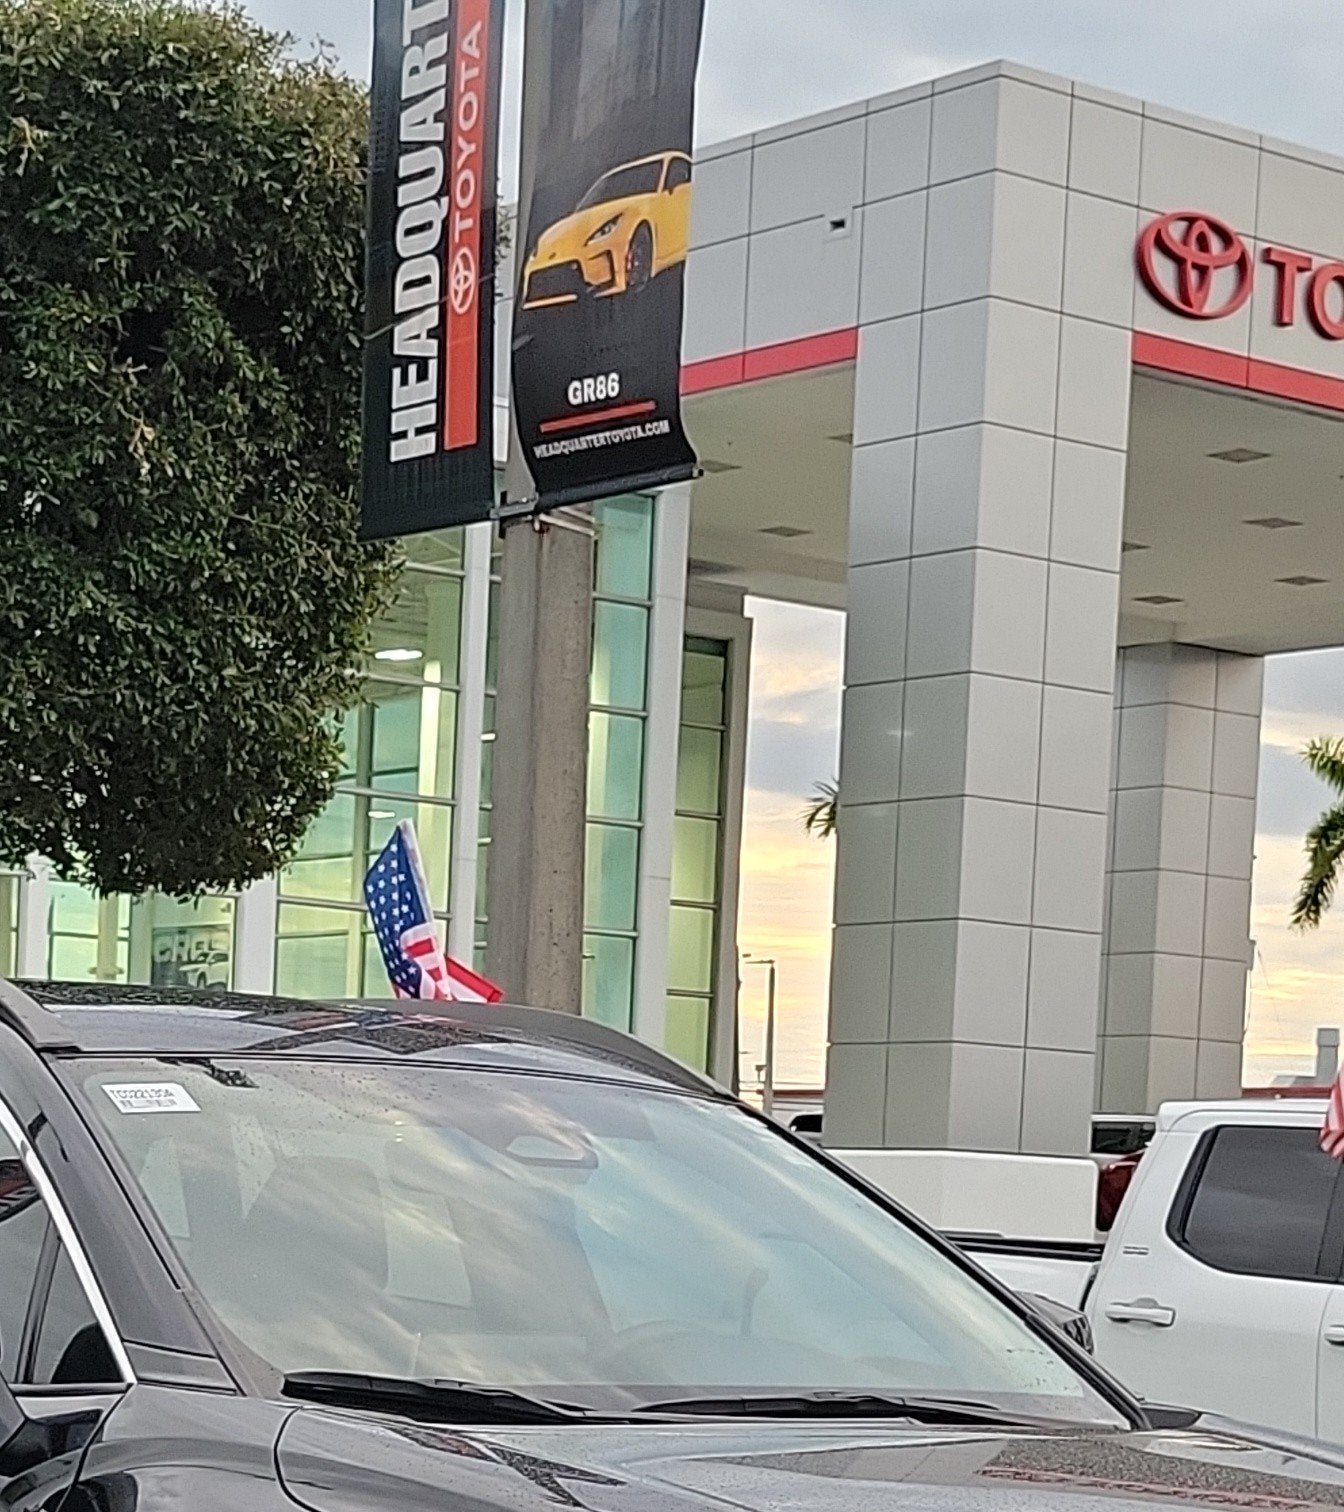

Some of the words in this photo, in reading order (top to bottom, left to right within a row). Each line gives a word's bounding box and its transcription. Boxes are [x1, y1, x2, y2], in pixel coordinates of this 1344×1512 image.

[455, 20, 483, 243] TOYOTA
[567, 372, 620, 405] GR86
[532, 419, 671, 459] HEADQUARTERTOYOTA.COM
